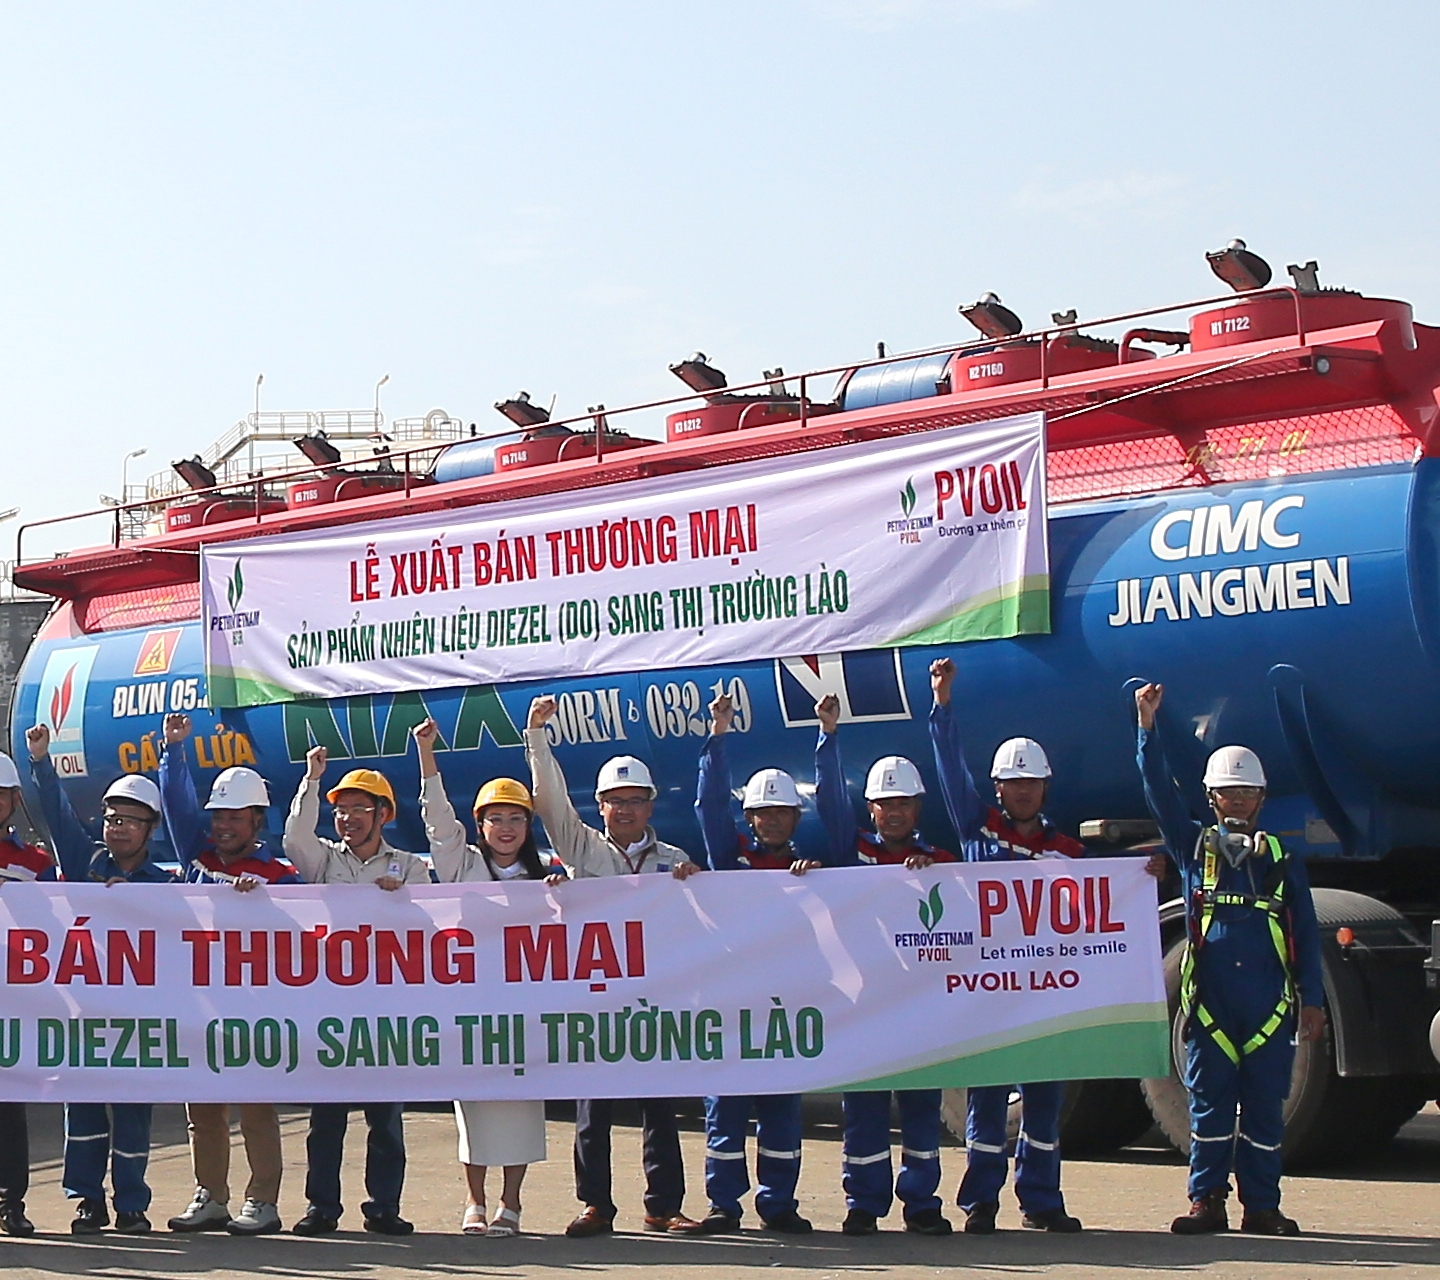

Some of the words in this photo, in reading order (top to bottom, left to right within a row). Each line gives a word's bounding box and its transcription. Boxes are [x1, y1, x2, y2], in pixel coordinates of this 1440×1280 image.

[1210, 322, 1222, 336] H1
[1225, 317, 1250, 332] 7122
[934, 460, 1027, 521] PVOIL
[900, 531, 921, 544] PVOIL
[938, 522, 975, 538] Đường
[976, 523, 989, 532] xa
[990, 520, 1016, 532] thêm
[1149, 494, 1304, 561] CIMC
[349, 543, 382, 603] LỄ
[390, 532, 464, 597] XUẤT
[474, 524, 537, 589] BÁN
[547, 515, 677, 577] THƯƠNG
[690, 503, 759, 567] MẠI
[1108, 556, 1351, 627] JIANGMEN
[287, 610, 322, 670] SẢN
[326, 611, 376, 663] PHẨM
[381, 609, 438, 661] NHIÊN
[441, 606, 481, 661] LIỆU
[486, 604, 552, 650] DIEZEL
[558, 599, 600, 644] (DO)
[608, 590, 663, 637] SANG
[669, 586, 704, 637] THỊ
[708, 569, 798, 623] TRƯỜNG
[805, 562, 849, 616] LÀO
[113, 682, 167, 718] ĐLVN
[61, 756, 83, 774] OIL
[194, 723, 257, 769] LỬA
[977, 876, 1126, 938] PVOIL
[6, 916, 157, 987] BÁN
[182, 924, 477, 987] THƯƠNG
[503, 920, 646, 993] MẠI
[895, 931, 974, 947] PETROVIETNAM
[918, 947, 952, 962] PVOIL
[981, 946, 1005, 960] Let
[1011, 943, 1054, 959] miles
[1059, 943, 1078, 957] be
[1083, 941, 1127, 956] smile
[946, 971, 1022, 994] PVOIL
[1030, 969, 1079, 991] LAO
[36, 1017, 190, 1069] DIEZEL
[205, 1017, 299, 1075] (DO)
[316, 1014, 441, 1069] SANG
[455, 1013, 525, 1077] THỊ
[540, 997, 723, 1064] TRƯỜNG
[739, 997, 825, 1061] LÀO
